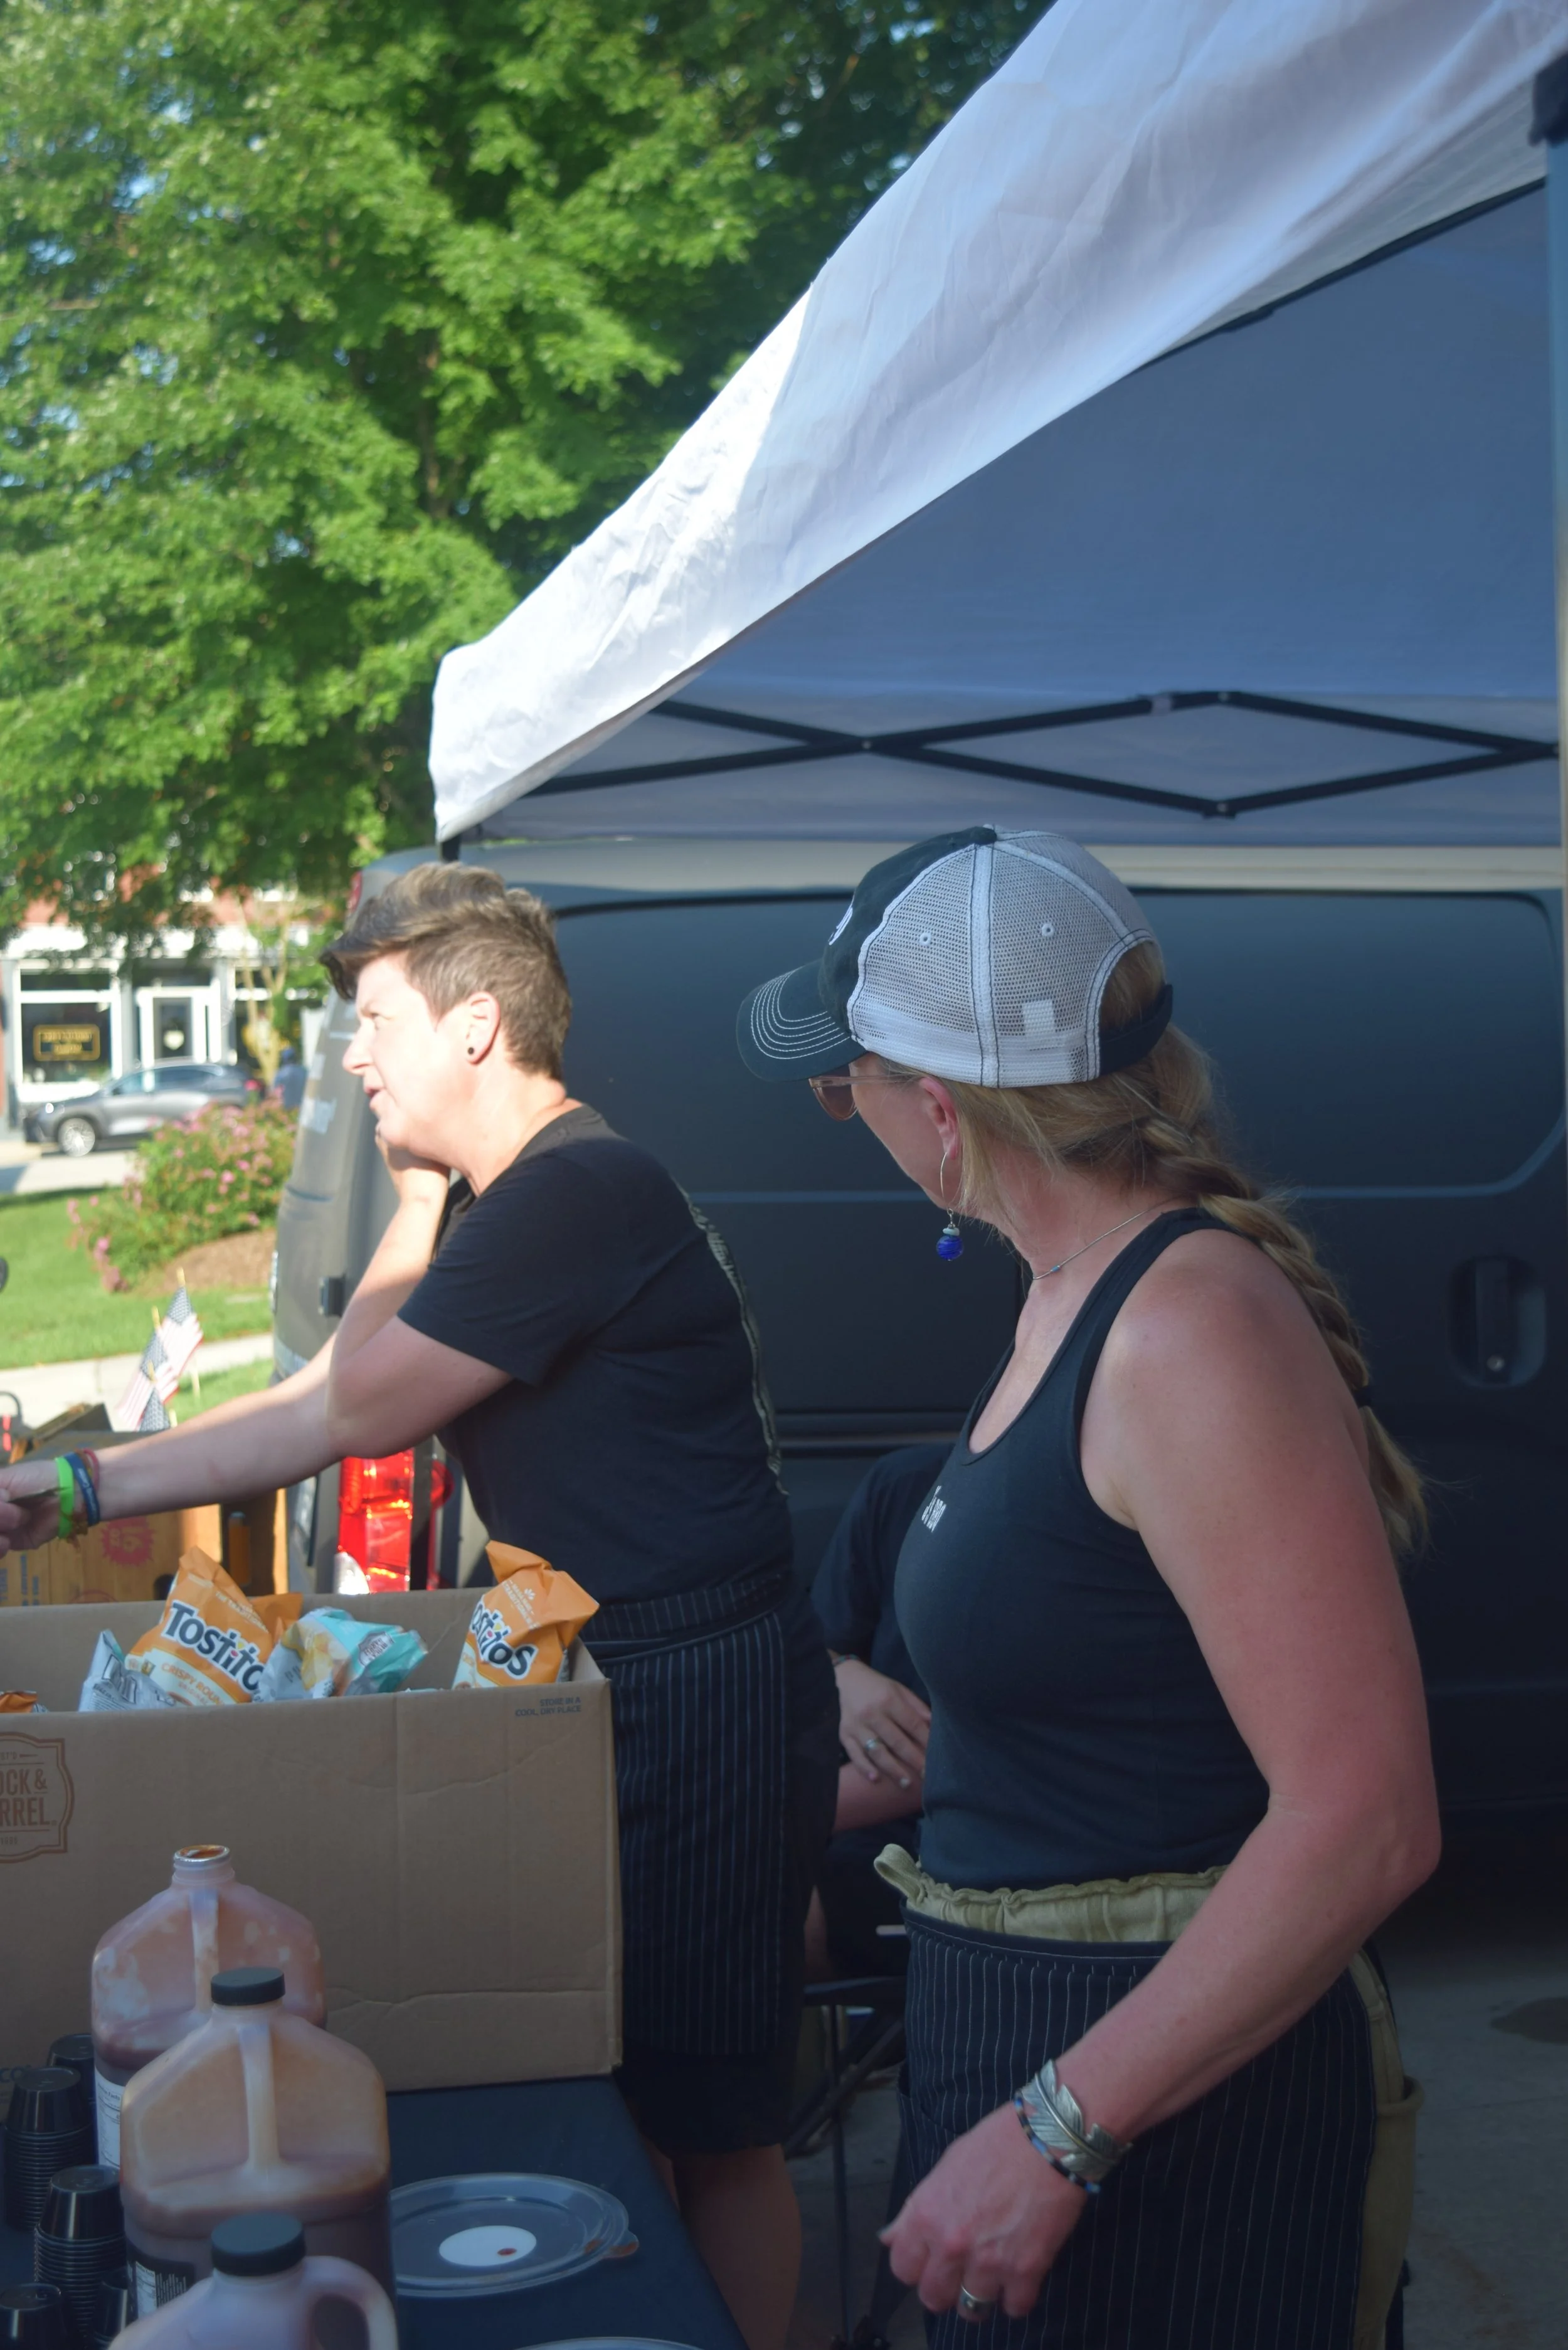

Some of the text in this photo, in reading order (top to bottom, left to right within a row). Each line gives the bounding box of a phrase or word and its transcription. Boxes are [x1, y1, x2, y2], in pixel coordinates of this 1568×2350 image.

[161, 1662, 198, 1685] CRISPY
[540, 1698, 563, 1706] STORE
[540, 1707, 554, 1715] DRY
[557, 1705, 581, 1713] PLACE
[34, 1769, 48, 1790] &
